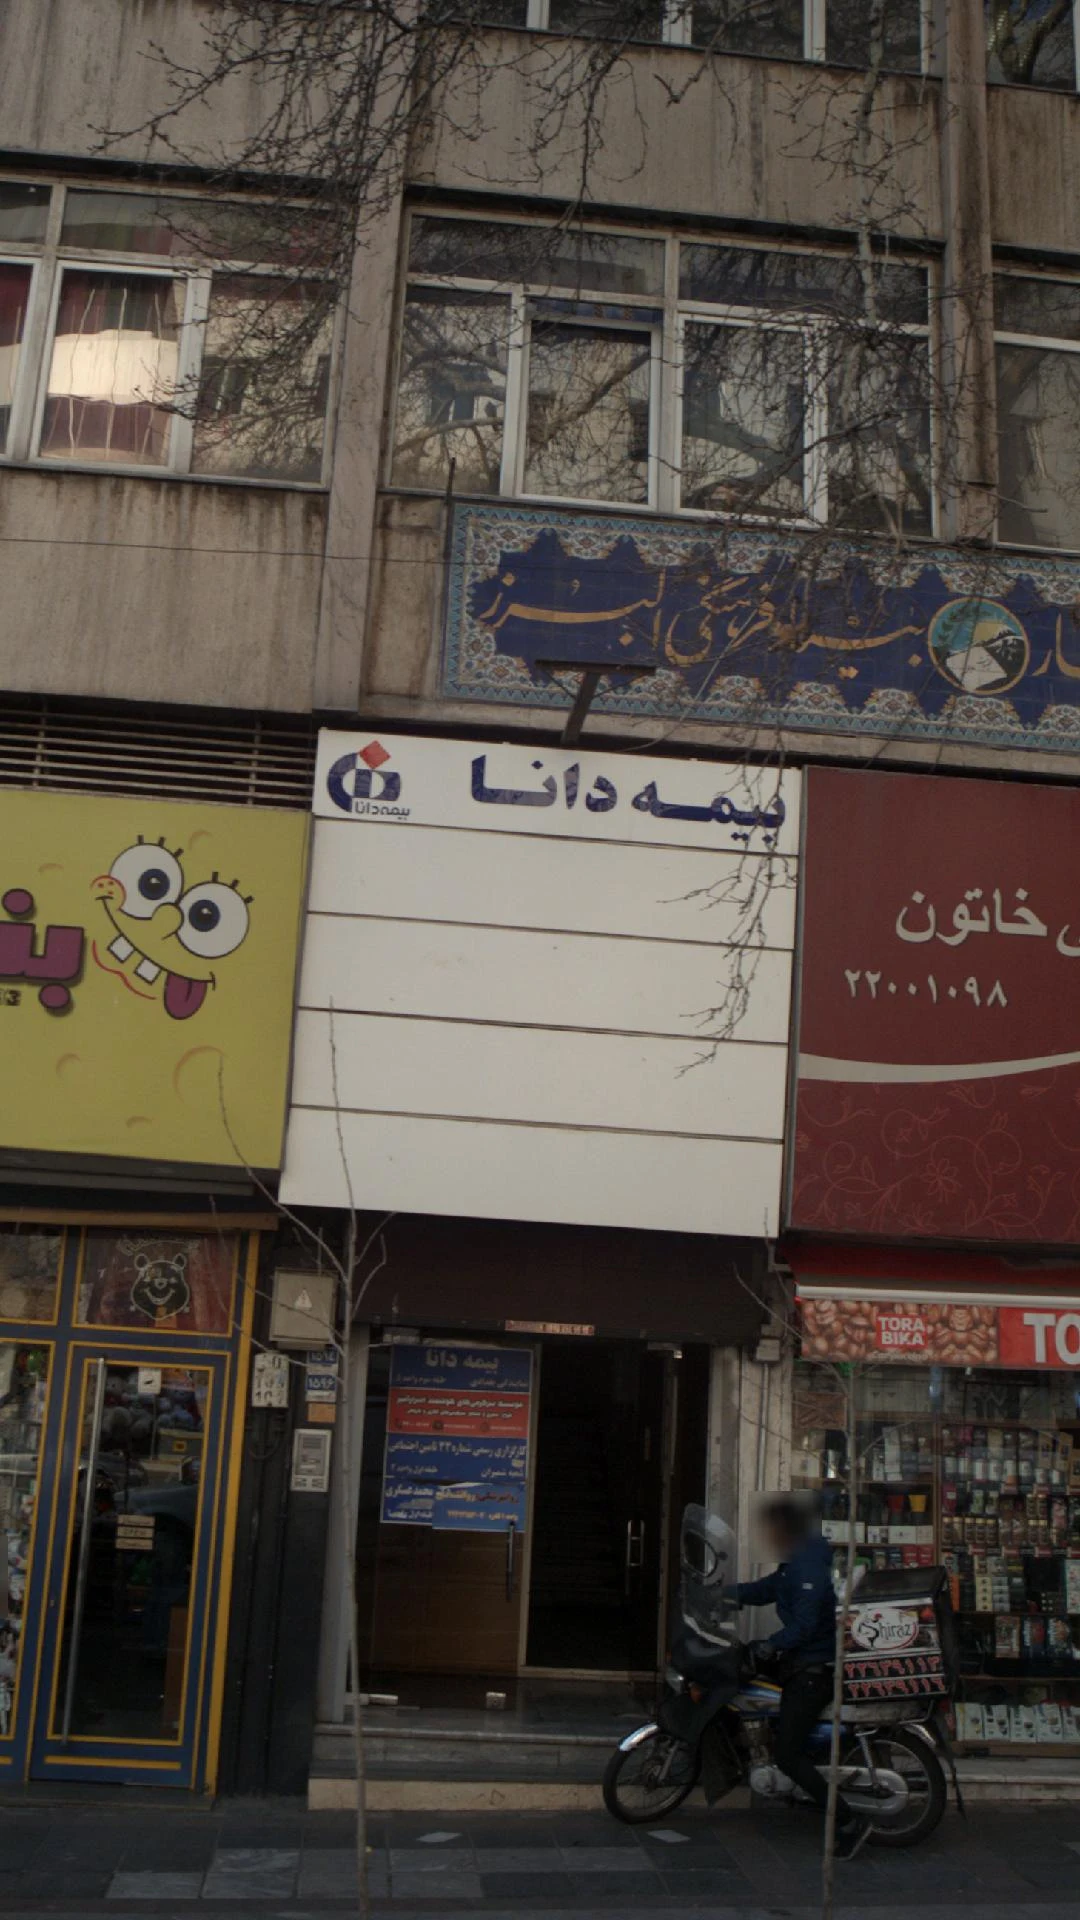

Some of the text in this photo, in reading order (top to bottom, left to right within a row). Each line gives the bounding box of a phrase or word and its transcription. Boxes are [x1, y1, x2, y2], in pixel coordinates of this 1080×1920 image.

[355, 801, 379, 815] دانا
[470, 754, 787, 844] بیمه دانا
[895, 888, 1048, 946] خاتون
[844, 968, 1008, 1007] ۲۲۰۰۱۰۹۸
[878, 1316, 926, 1332] TORA
[881, 1331, 925, 1346] BIKA
[425, 1348, 498, 1374] بیمه دانا
[858, 1621, 911, 1649] Shiraz
